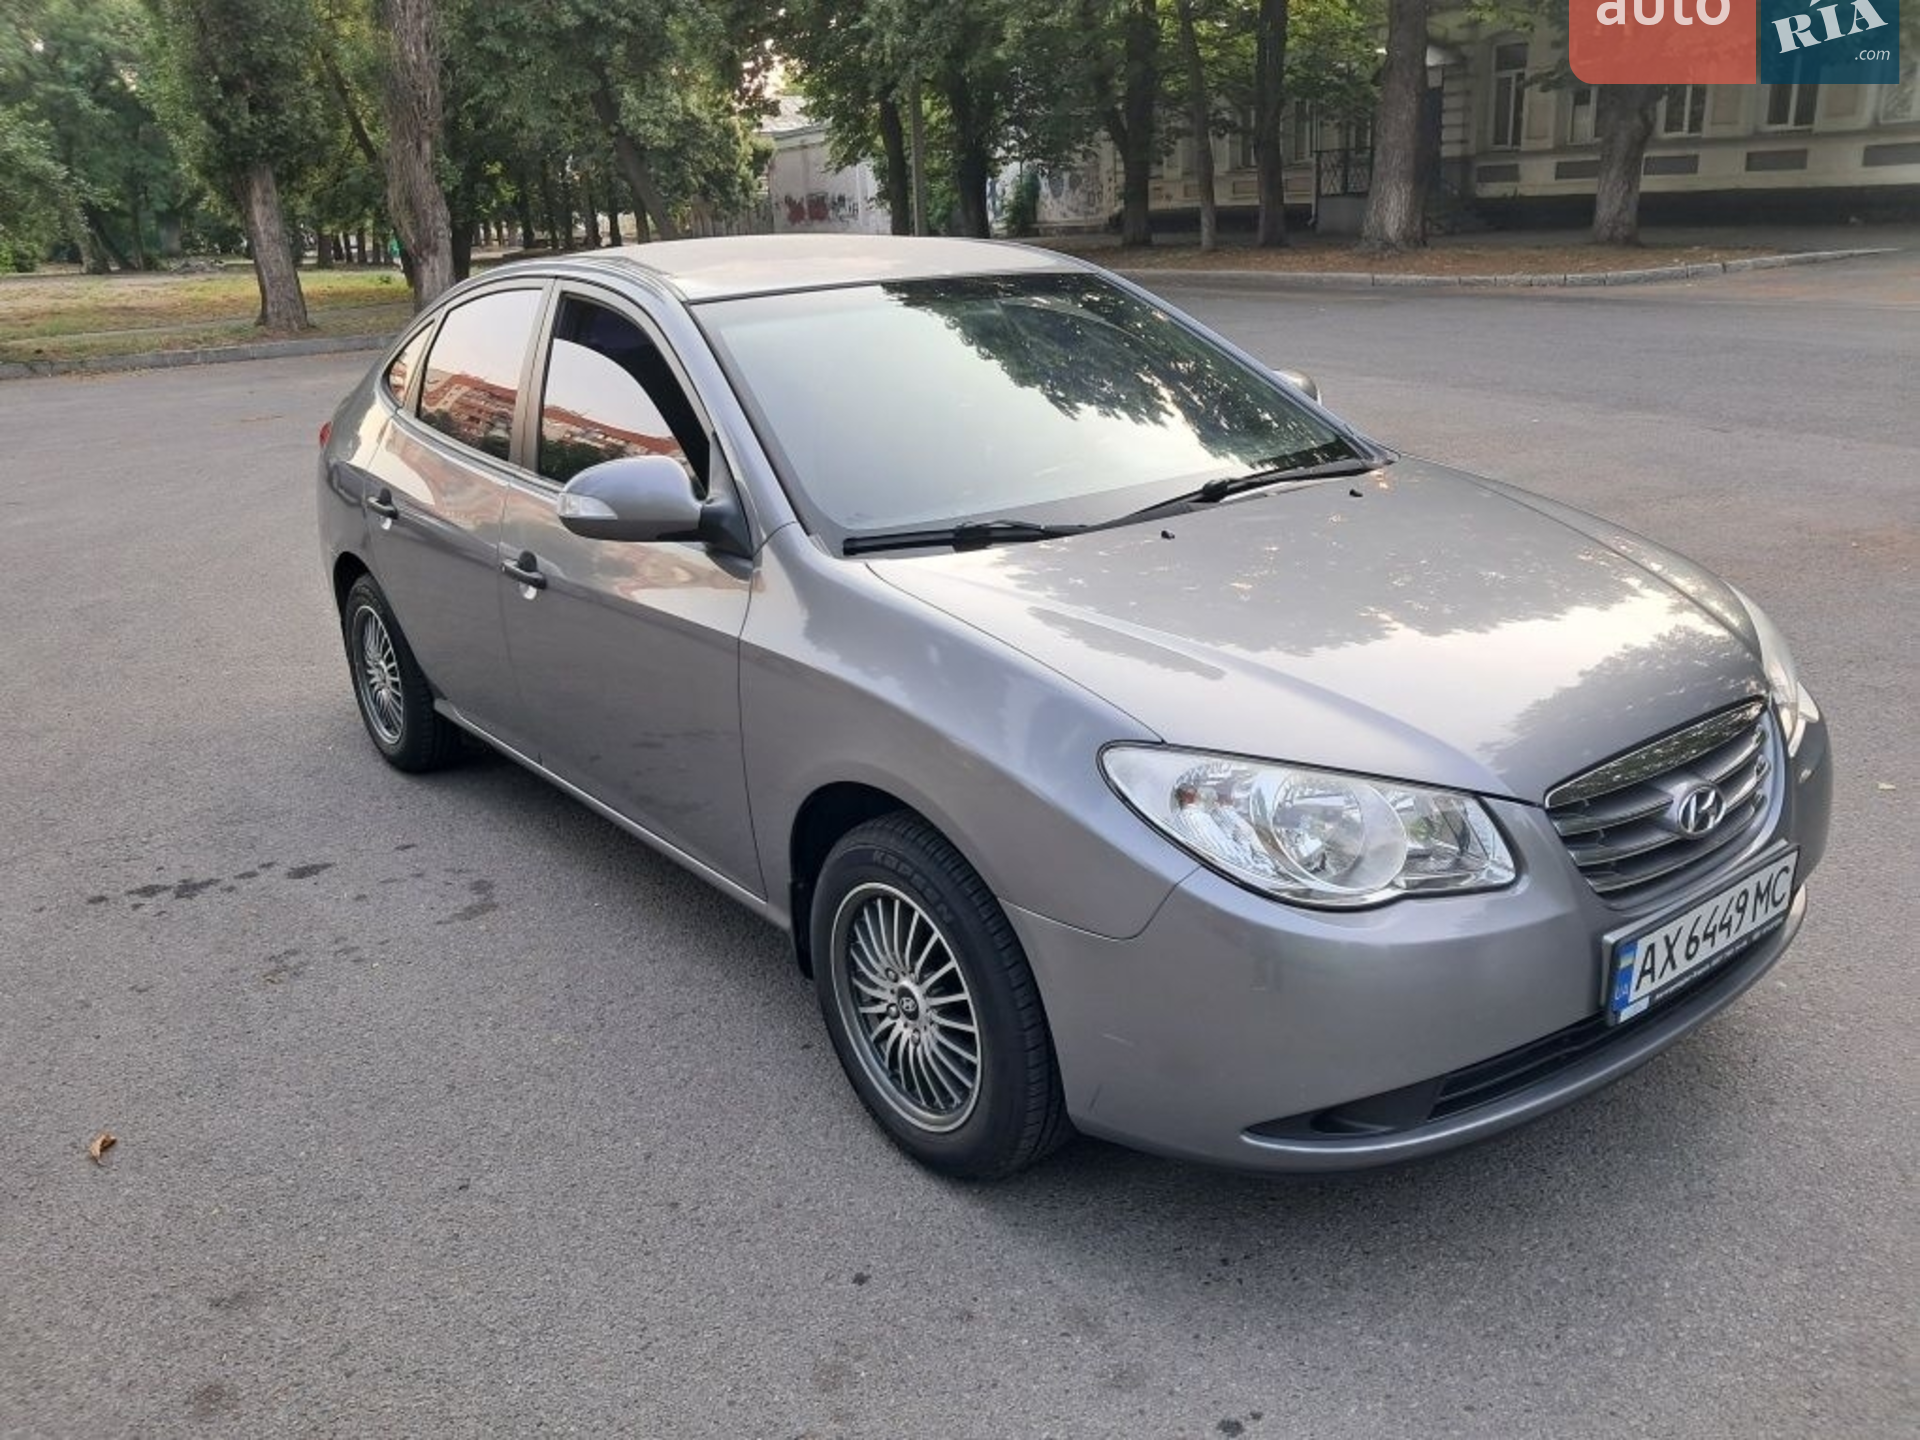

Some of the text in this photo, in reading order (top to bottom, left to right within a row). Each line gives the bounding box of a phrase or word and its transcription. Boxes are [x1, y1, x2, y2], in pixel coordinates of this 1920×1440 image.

[1635, 925, 1684, 992] AX
[1684, 887, 1750, 962] 6449
[1752, 865, 1790, 923] MC
